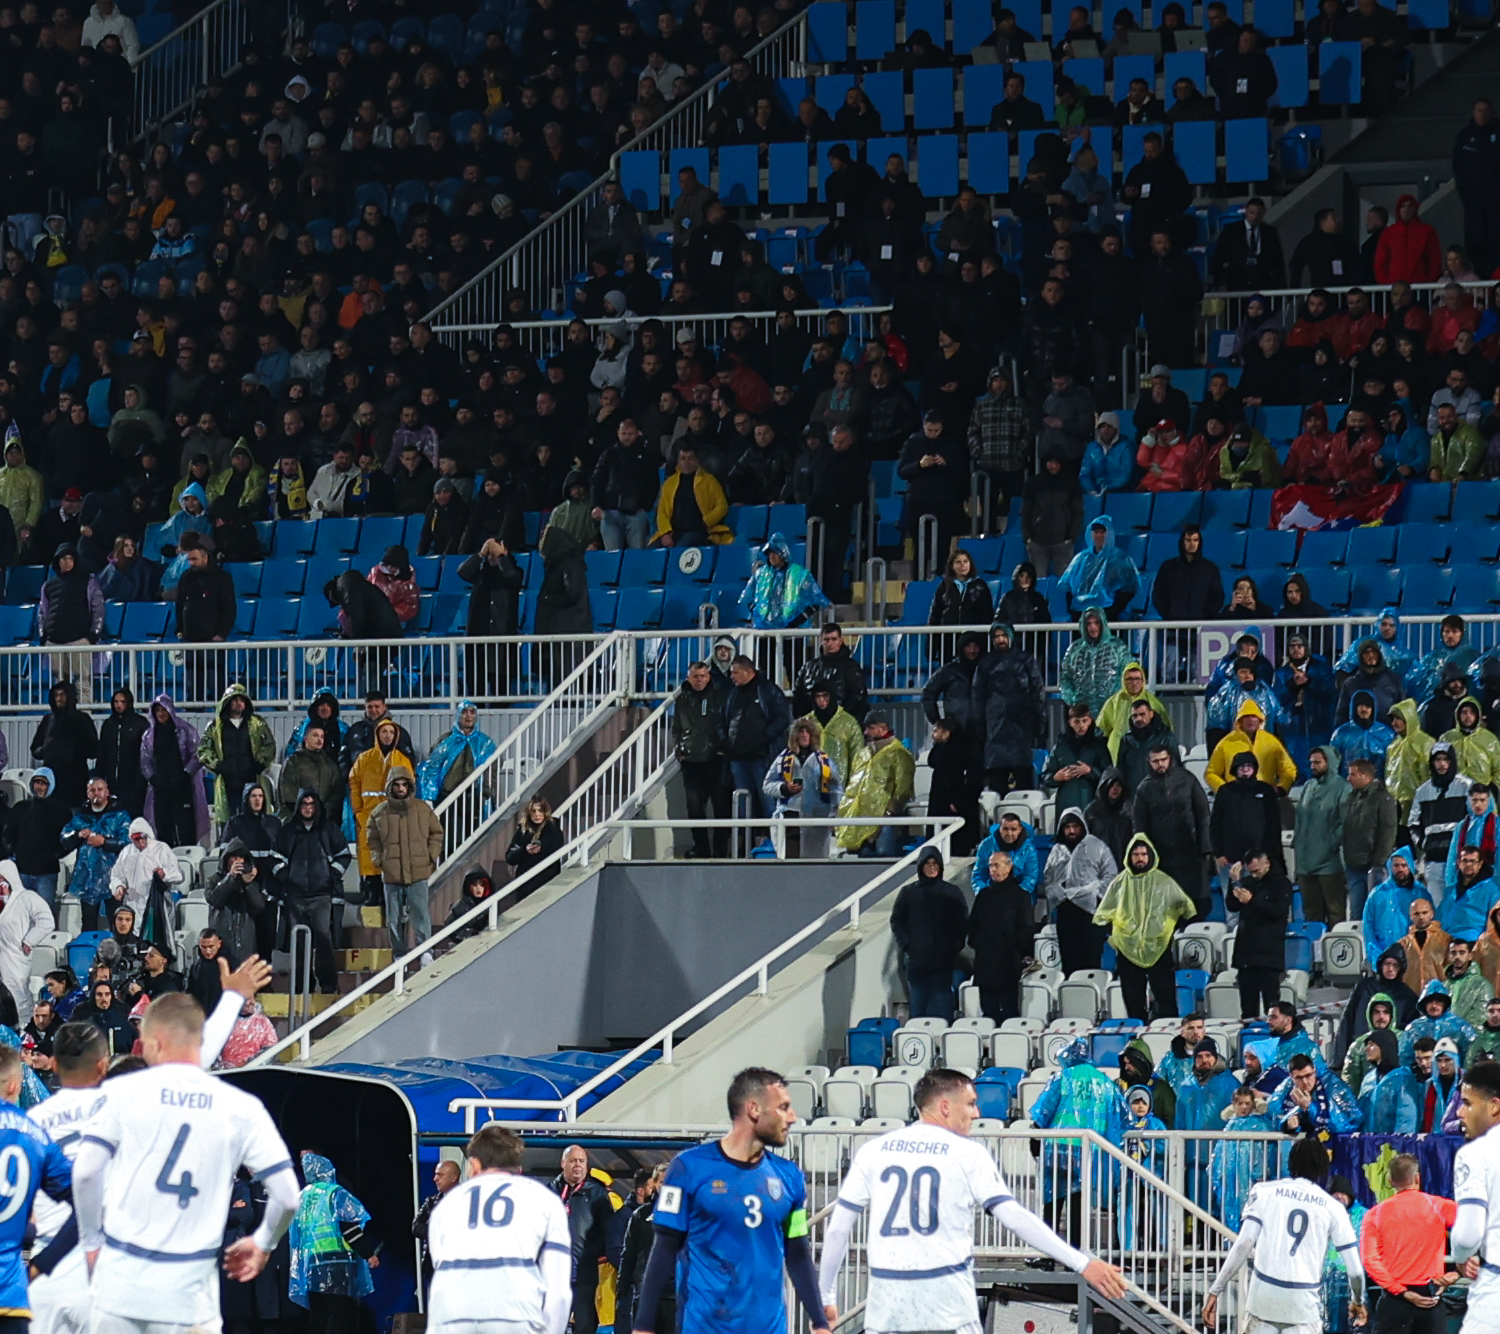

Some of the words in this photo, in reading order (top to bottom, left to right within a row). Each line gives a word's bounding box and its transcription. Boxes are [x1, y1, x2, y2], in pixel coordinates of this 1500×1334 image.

[351, 949, 359, 963] F
[161, 1087, 213, 1110] ELVEDI
[880, 1139, 950, 1155] AEBISCHER
[155, 1123, 198, 1209] 4
[467, 1182, 515, 1230] 16
[744, 1194, 763, 1228] 3
[879, 1165, 941, 1237] 20
[1275, 1188, 1327, 1208] MANZAMBI
[1286, 1208, 1309, 1257] 9
